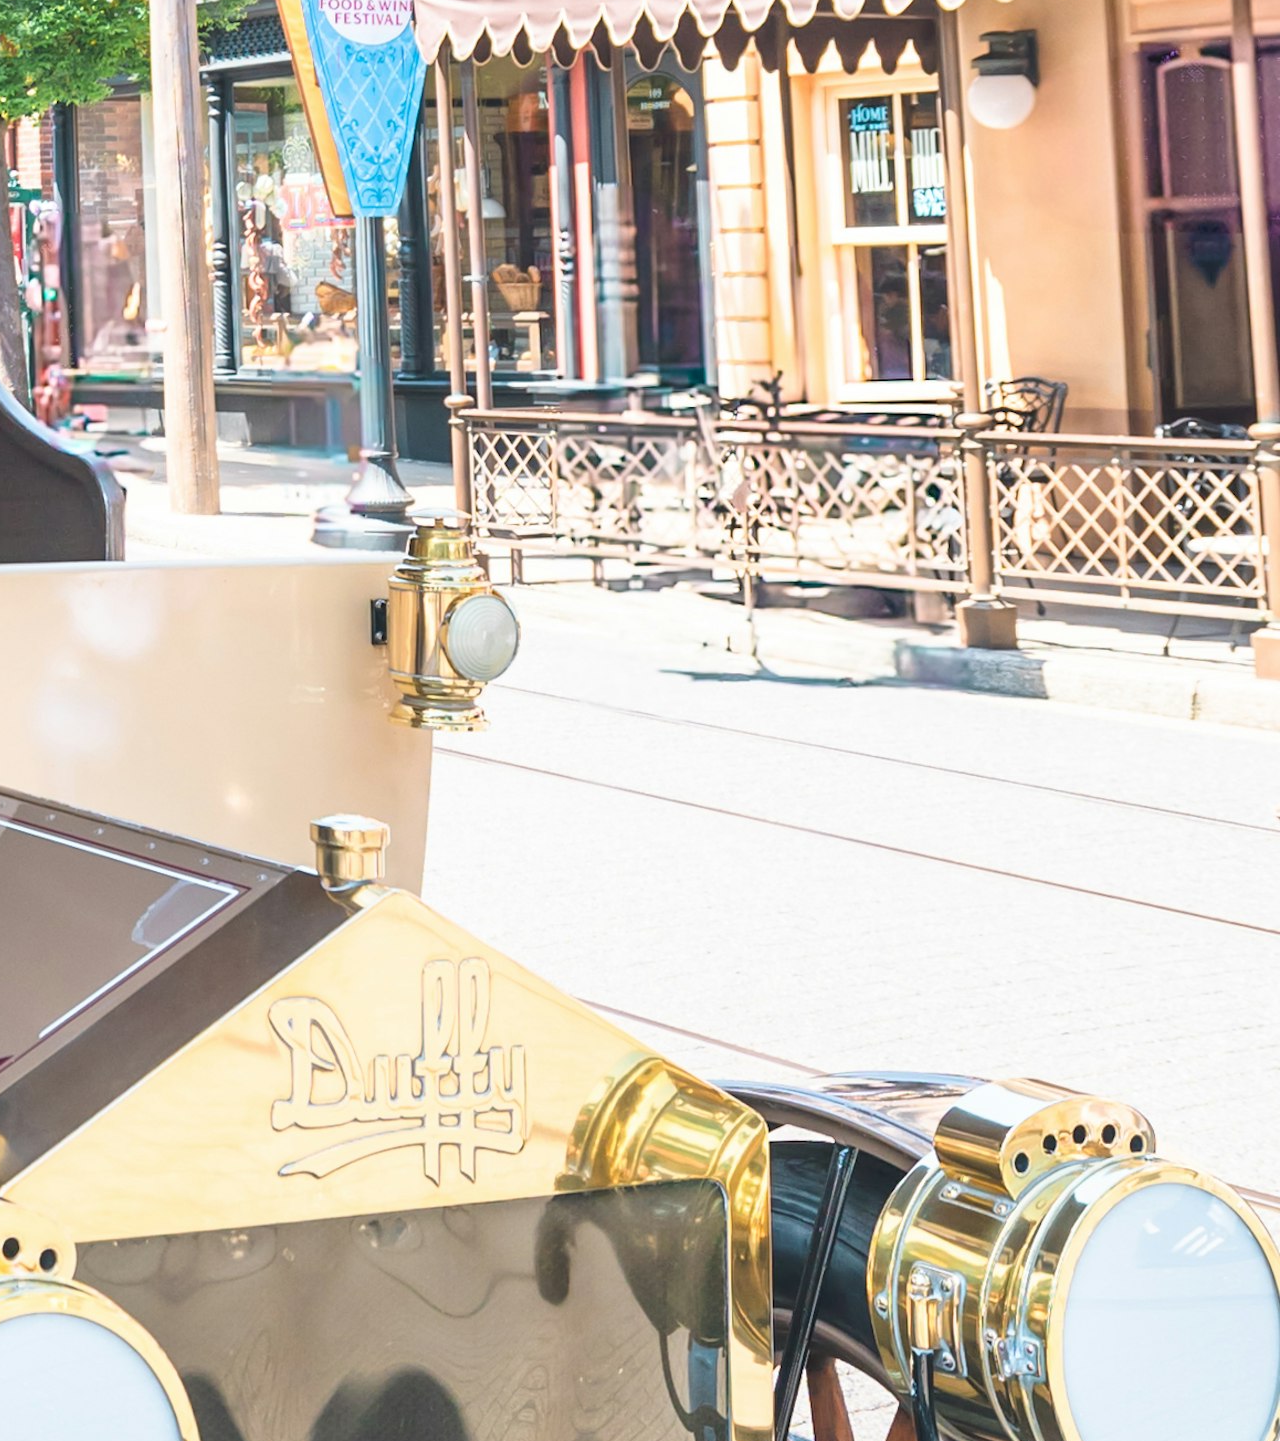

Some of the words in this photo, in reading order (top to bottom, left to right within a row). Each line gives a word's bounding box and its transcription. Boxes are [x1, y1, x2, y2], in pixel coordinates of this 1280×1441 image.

[366, 0, 377, 12] &
[334, 12, 404, 27] FESTIVAL
[848, 104, 889, 123] HOME
[268, 956, 527, 1187] Duffy
